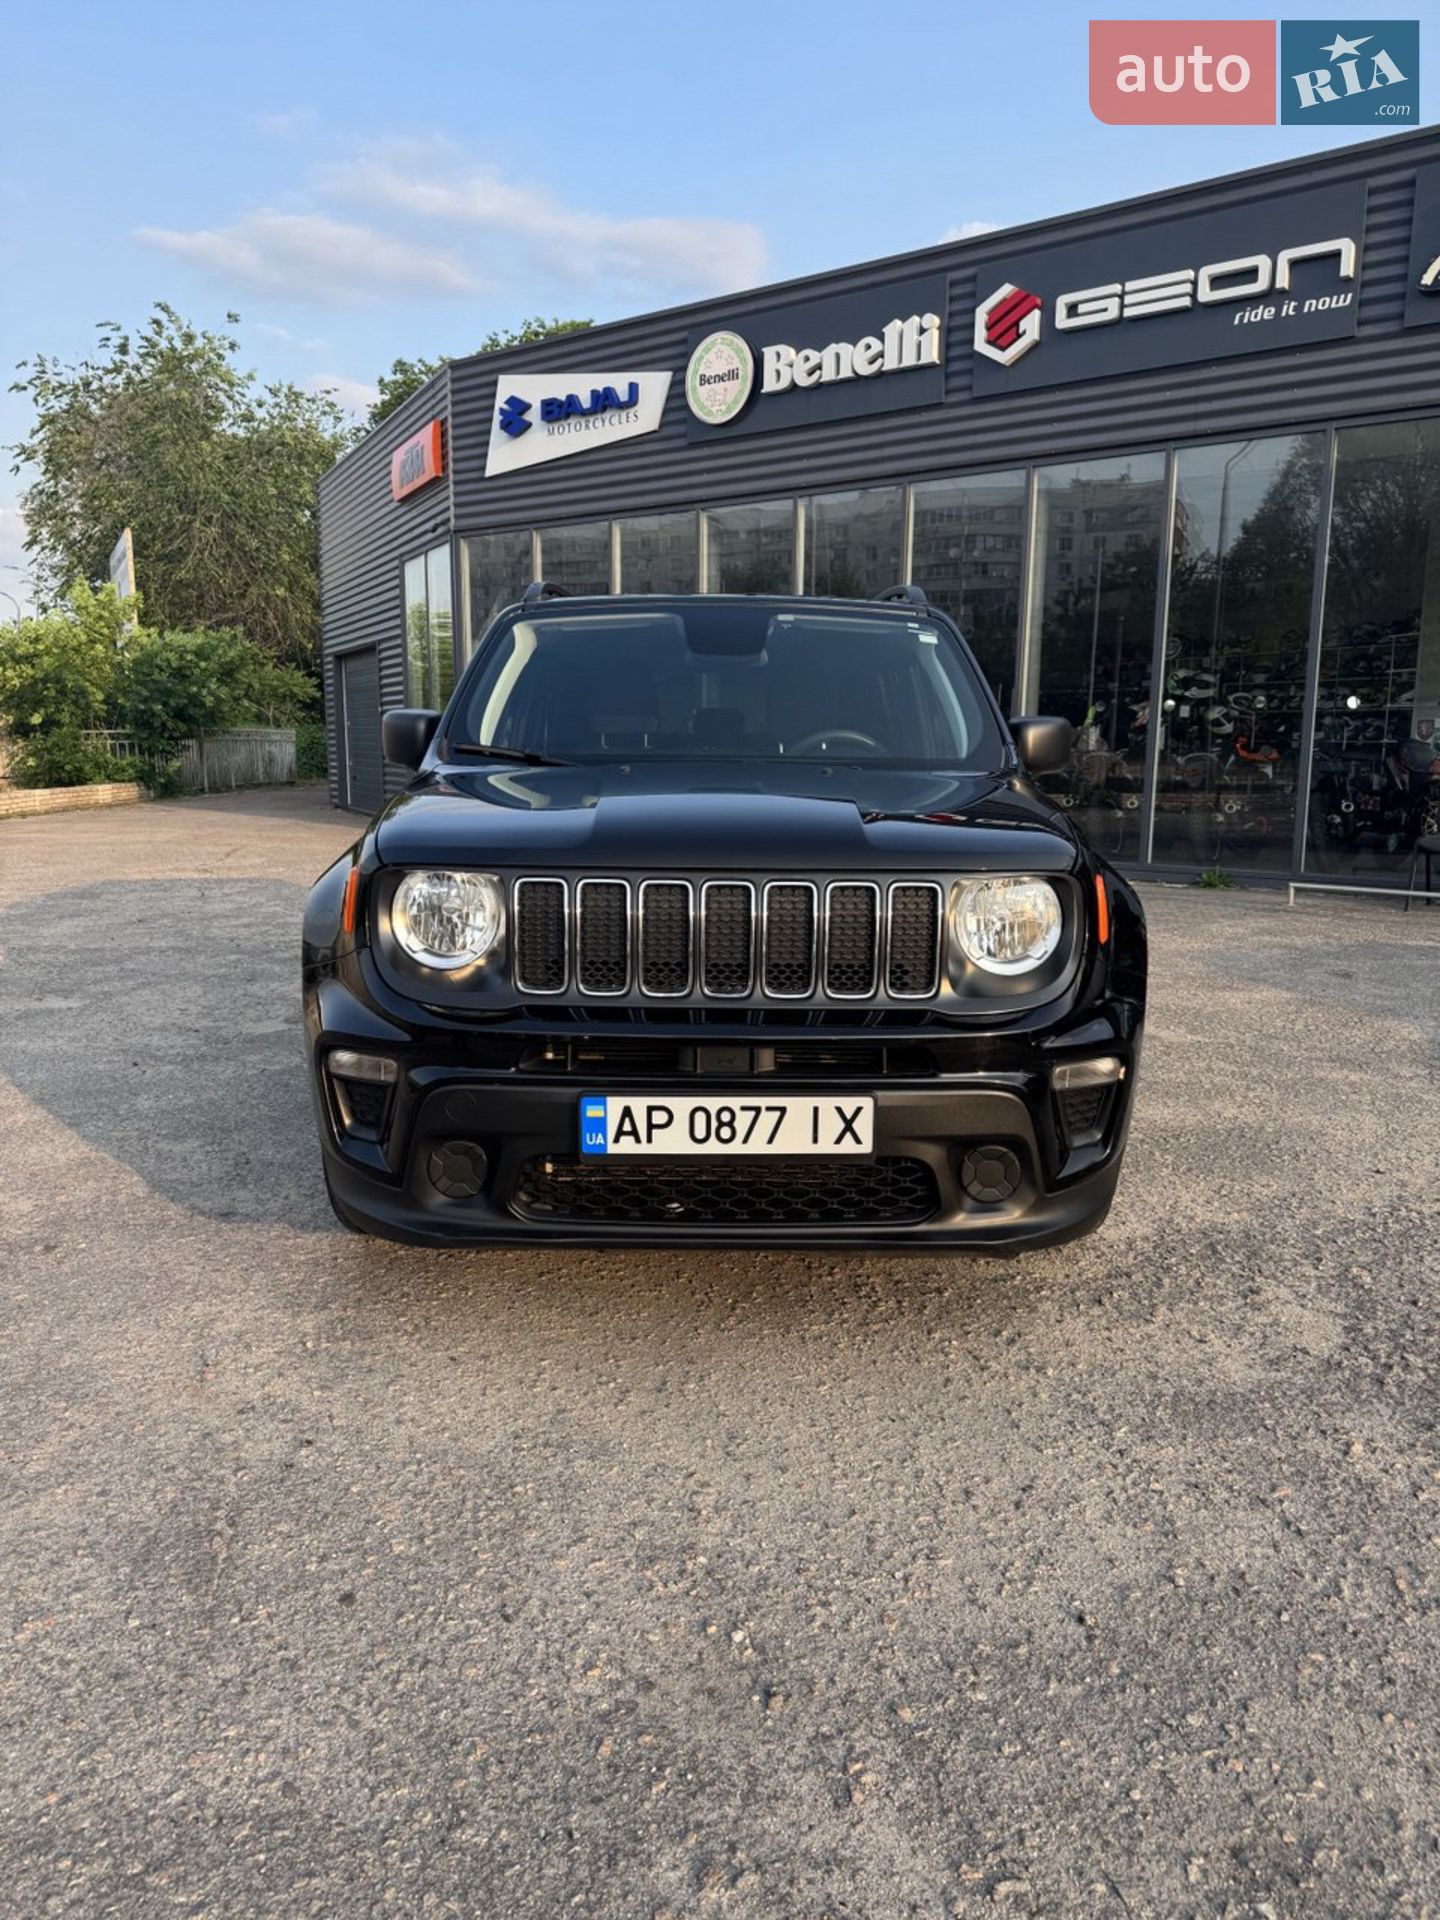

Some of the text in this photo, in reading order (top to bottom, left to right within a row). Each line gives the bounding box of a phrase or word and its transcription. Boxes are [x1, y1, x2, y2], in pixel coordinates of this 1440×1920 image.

[1233, 292, 1353, 325] ride it now
[761, 313, 940, 394] Benelli
[699, 367, 739, 387] Benelli
[540, 382, 639, 423] BAJAJ
[547, 410, 639, 437] MOTORCYCLES
[586, 1133, 605, 1146] UA
[612, 1105, 674, 1144] AP
[689, 1106, 787, 1144] 0877
